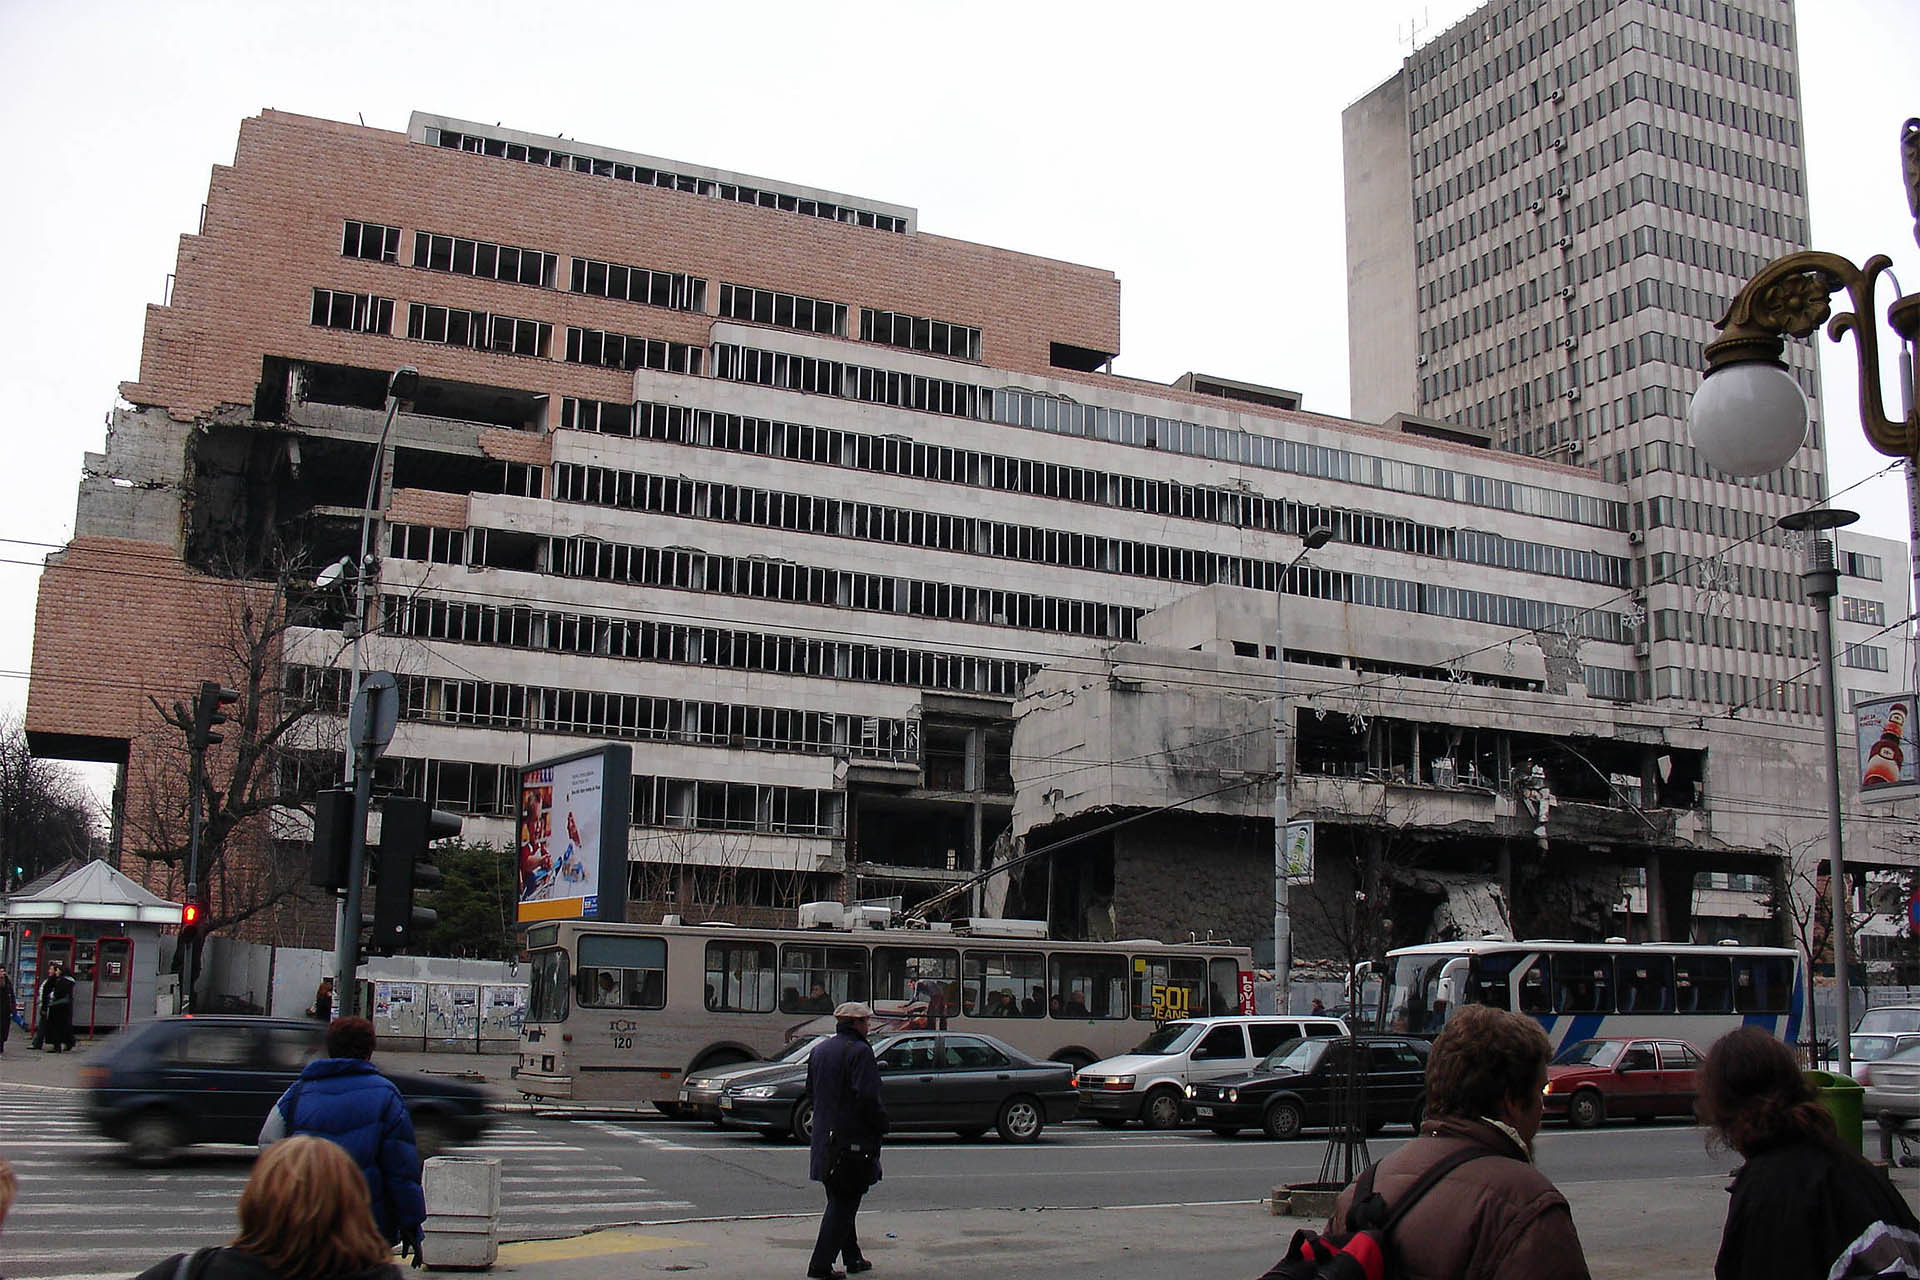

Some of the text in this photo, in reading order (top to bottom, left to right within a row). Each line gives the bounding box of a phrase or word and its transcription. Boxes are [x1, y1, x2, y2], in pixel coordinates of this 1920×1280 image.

[1151, 984, 1190, 1011] 501
[1151, 1005, 1190, 1020] JEANS
[614, 1037, 633, 1049] 120
